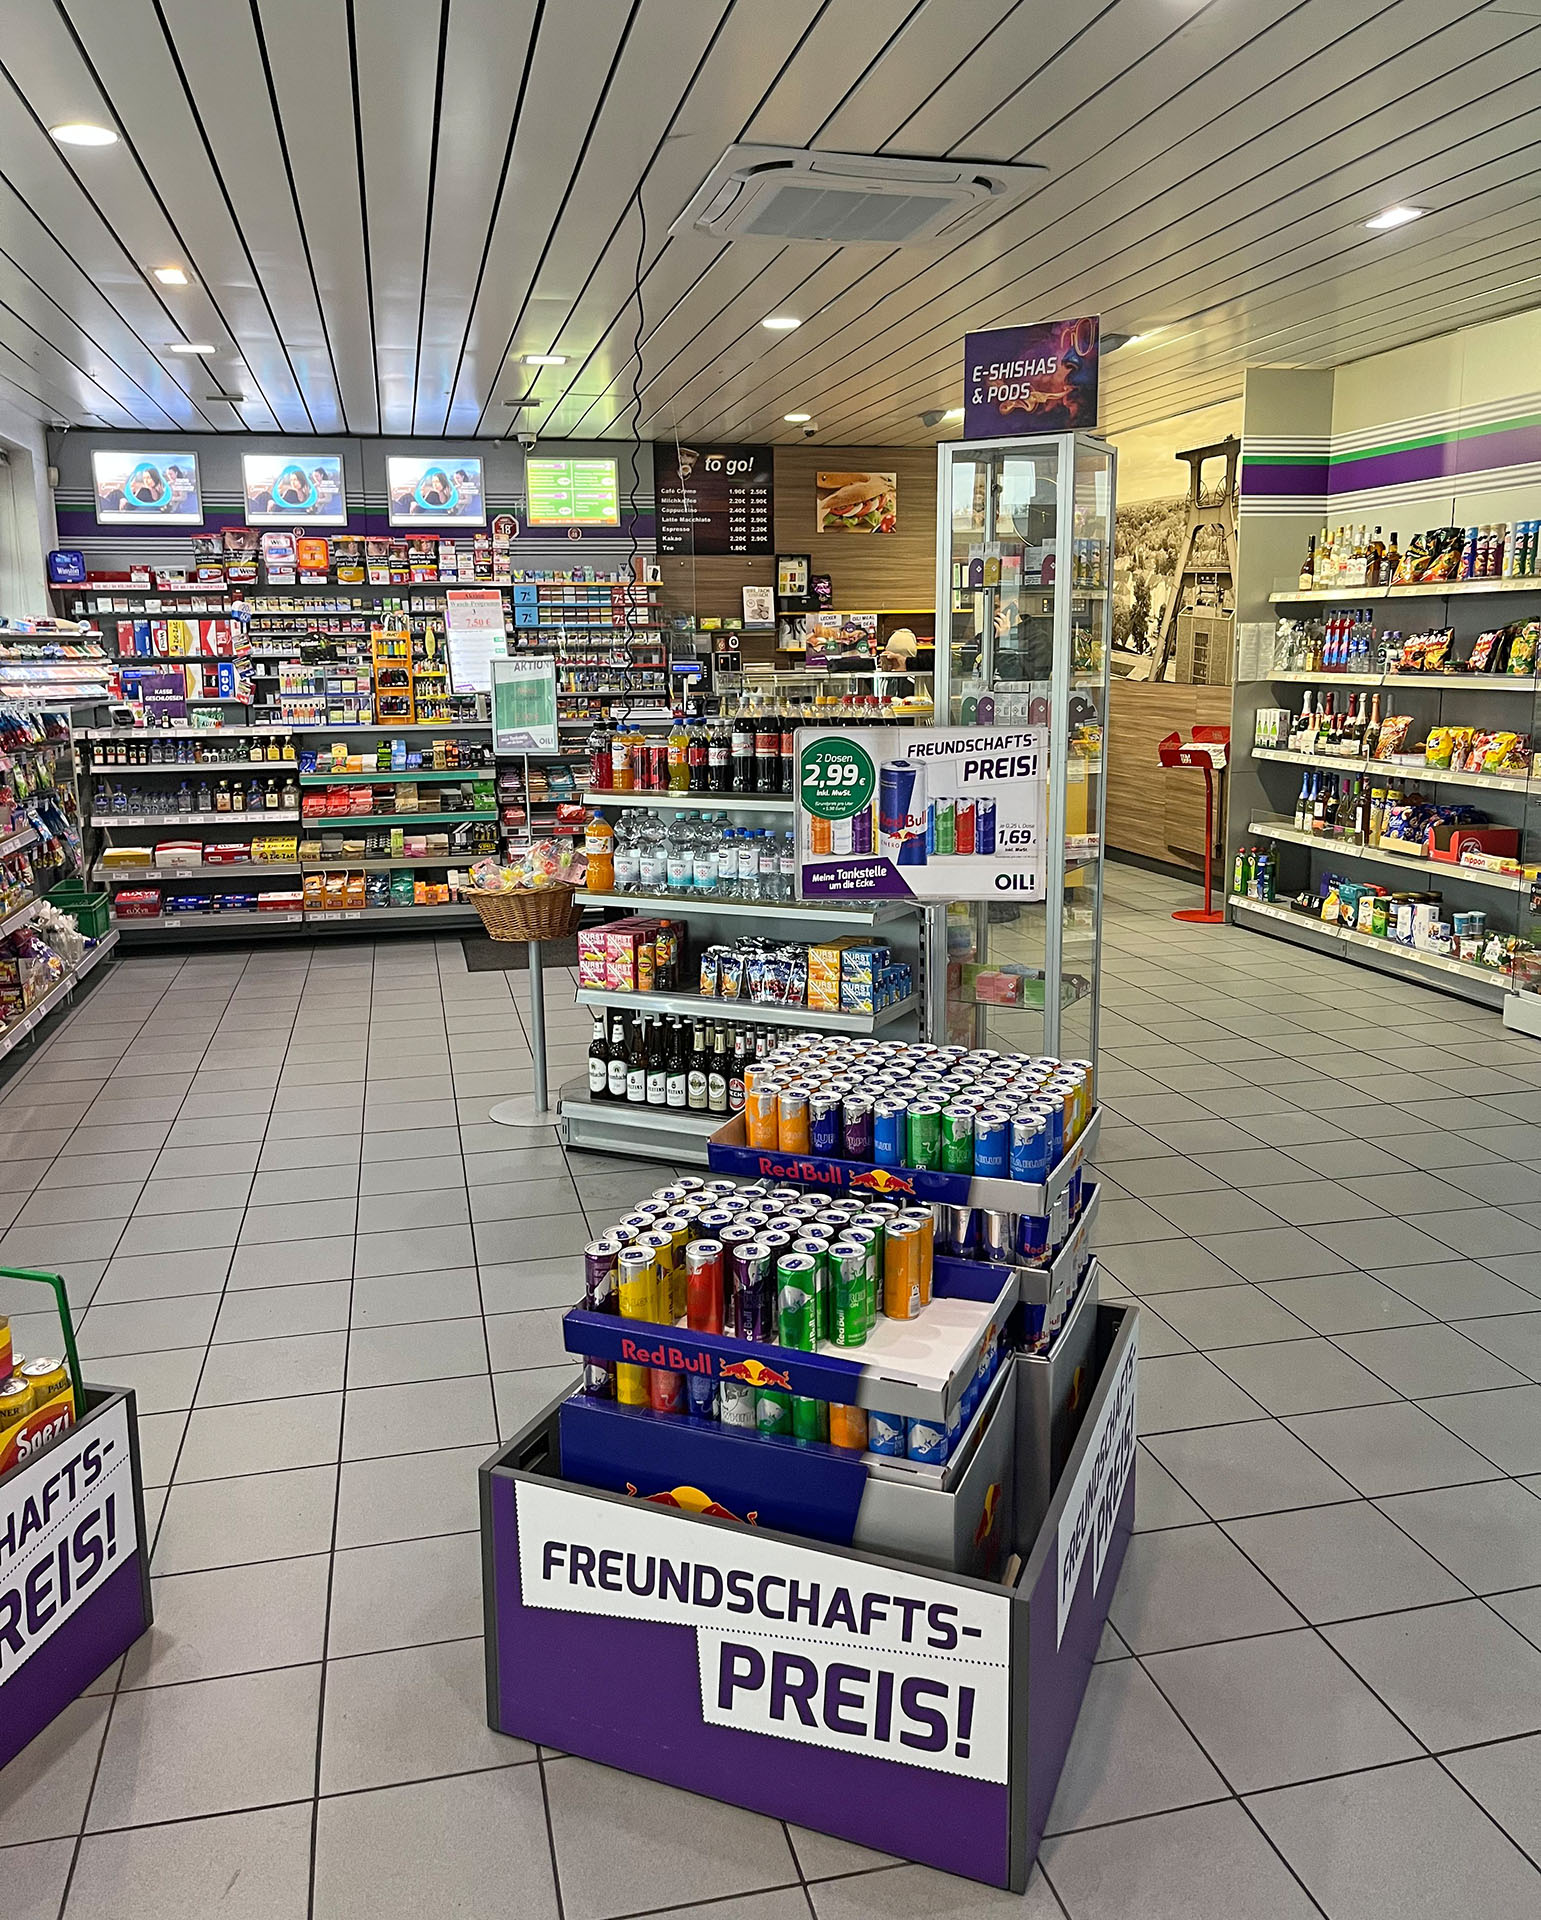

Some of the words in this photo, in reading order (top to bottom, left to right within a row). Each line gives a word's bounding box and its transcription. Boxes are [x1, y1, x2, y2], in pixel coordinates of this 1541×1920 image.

[972, 356, 1058, 382] E-SHISHAS
[971, 387, 983, 405] &
[987, 382, 1031, 403] PODS
[704, 457, 721, 472] to
[726, 456, 754, 475] go!
[500, 524, 512, 535] 18
[466, 619, 484, 627] 7,50
[221, 669, 229, 692] OCB
[907, 734, 1037, 758] FREUNDSCHAFTS-
[815, 753, 823, 763] 2
[824, 753, 853, 763] Dosen
[803, 764, 859, 788] 2,99
[859, 778, 866, 786] €
[963, 754, 1038, 782] PREIS!
[880, 810, 903, 828] Red
[905, 809, 926, 828] Bull
[998, 830, 1031, 845] 1,69
[1464, 856, 1485, 867] nippon
[812, 873, 835, 883] Meine
[836, 866, 887, 879] Tankstelle
[995, 874, 1035, 891] OIL!
[829, 882, 842, 890] um
[842, 880, 855, 889] die
[855, 879, 876, 888] Ecke.
[758, 1157, 800, 1179] Red
[801, 1162, 843, 1185] Bull
[836, 1309, 845, 1326] Bull
[743, 1328, 753, 1342] ed
[836, 1327, 845, 1345] Red
[621, 1338, 666, 1366] Red
[668, 1347, 713, 1375] Bull
[1096, 1391, 1136, 1574] PREIS!
[0, 1491, 117, 1656] REIS!
[542, 1540, 982, 1651] FREUNDSCHAFTS-
[717, 1641, 977, 1759] PREIS!
